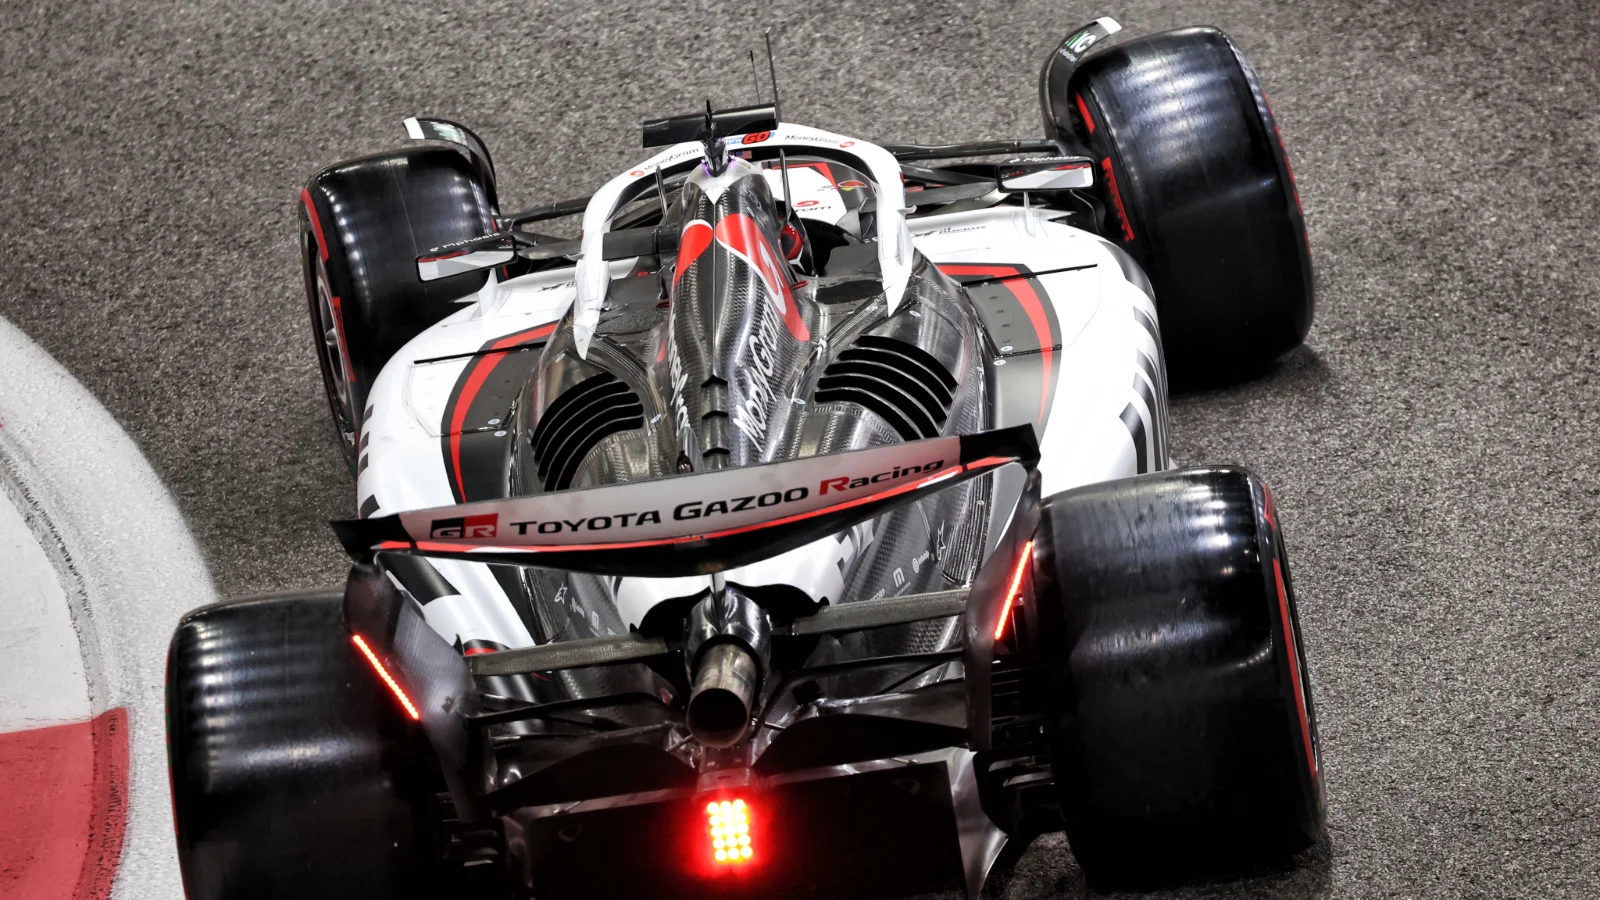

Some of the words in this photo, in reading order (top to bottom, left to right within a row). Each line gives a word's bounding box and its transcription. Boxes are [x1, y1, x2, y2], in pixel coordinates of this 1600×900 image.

[742, 131, 772, 145] GO
[783, 134, 840, 145] MoneyGram
[643, 147, 700, 172] MoneyGram
[430, 521, 499, 539] GR
[509, 509, 662, 536] TOYOTA
[672, 486, 810, 522] GAZOO
[818, 458, 945, 497] Racing
